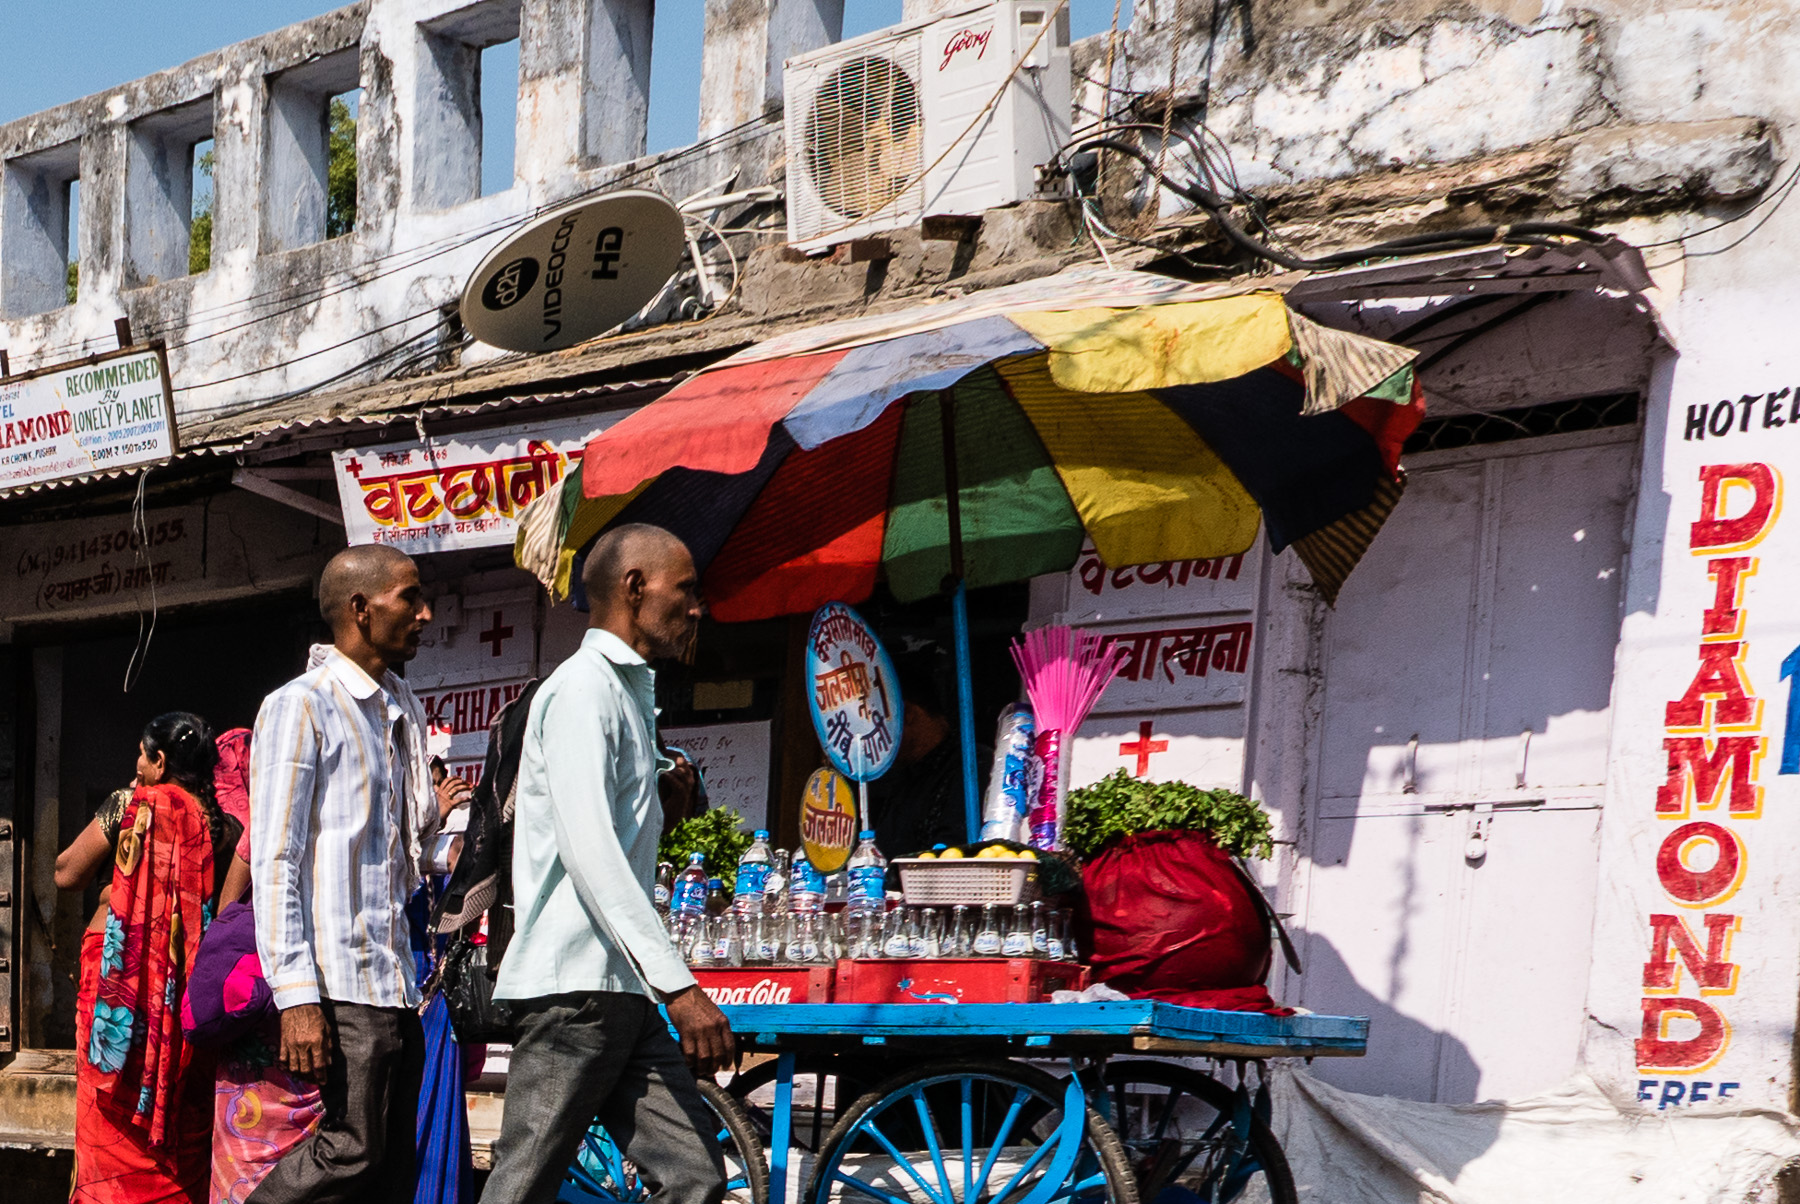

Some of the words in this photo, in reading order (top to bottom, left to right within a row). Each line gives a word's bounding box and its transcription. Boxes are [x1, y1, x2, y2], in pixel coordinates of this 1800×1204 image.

[939, 25, 994, 72] Godrej
[591, 226, 624, 280] HD
[65, 356, 160, 398] RECOMMENDED
[72, 404, 113, 434] LONELY
[116, 393, 162, 425] PLANET
[1634, 461, 1783, 1077] DIAMOND
